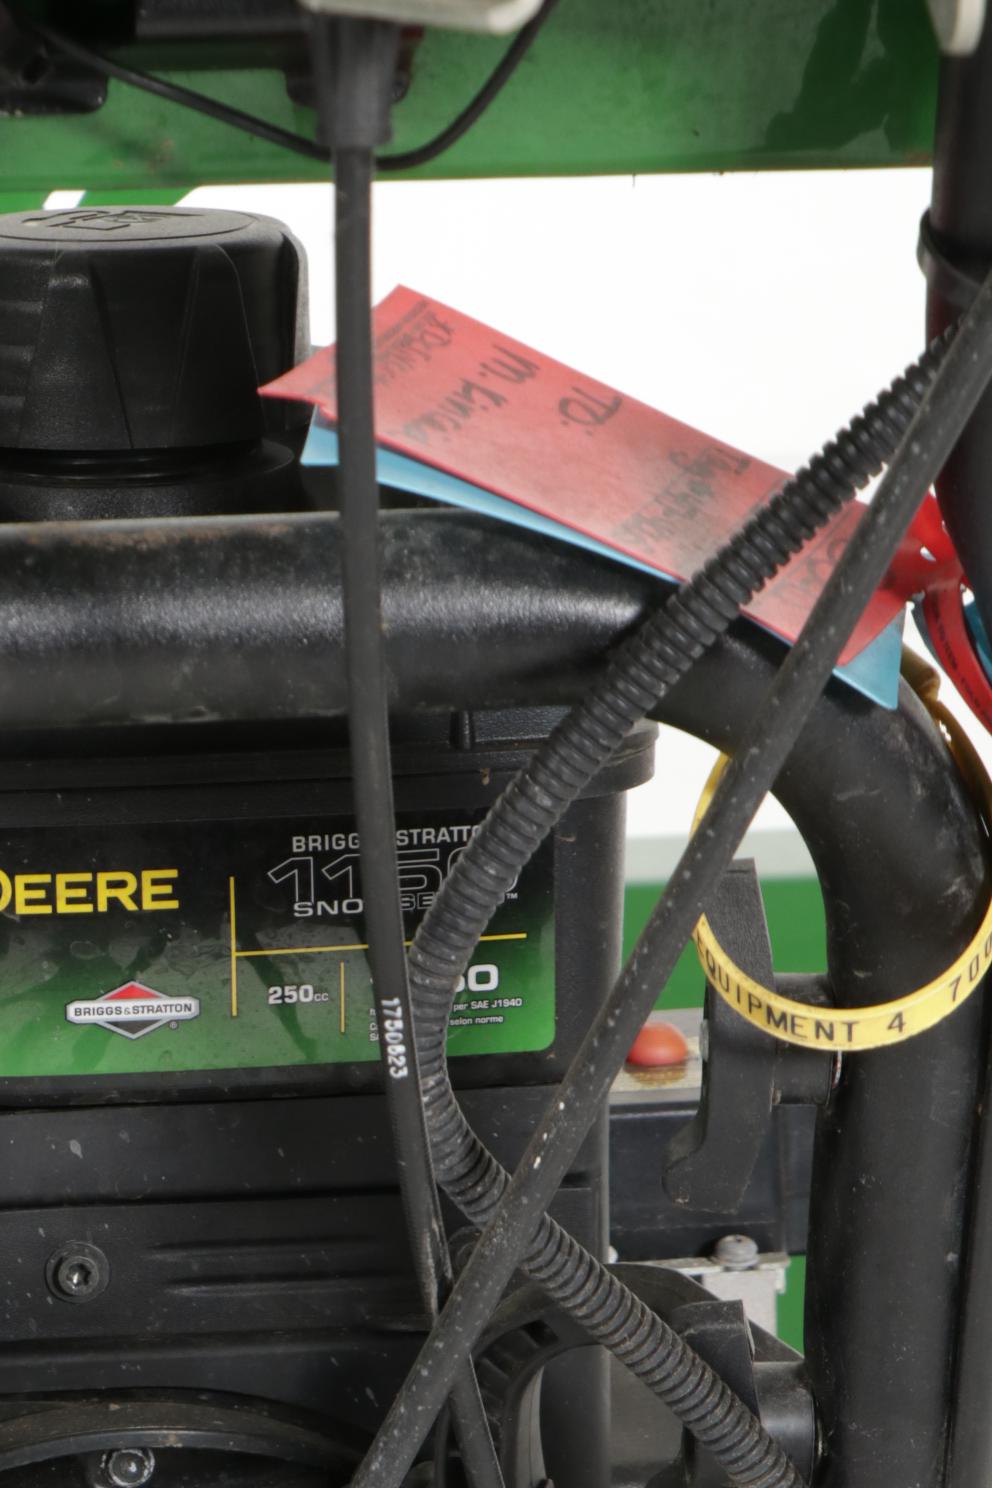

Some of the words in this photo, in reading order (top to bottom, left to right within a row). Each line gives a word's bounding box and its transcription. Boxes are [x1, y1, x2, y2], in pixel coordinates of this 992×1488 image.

[292, 833, 360, 852] BRIGG
[396, 826, 481, 846] STRATT
[293, 898, 365, 917] SNO
[471, 1001, 490, 1010] SAE
[475, 1015, 504, 1024] norme
[887, 1011, 907, 1033] 4
